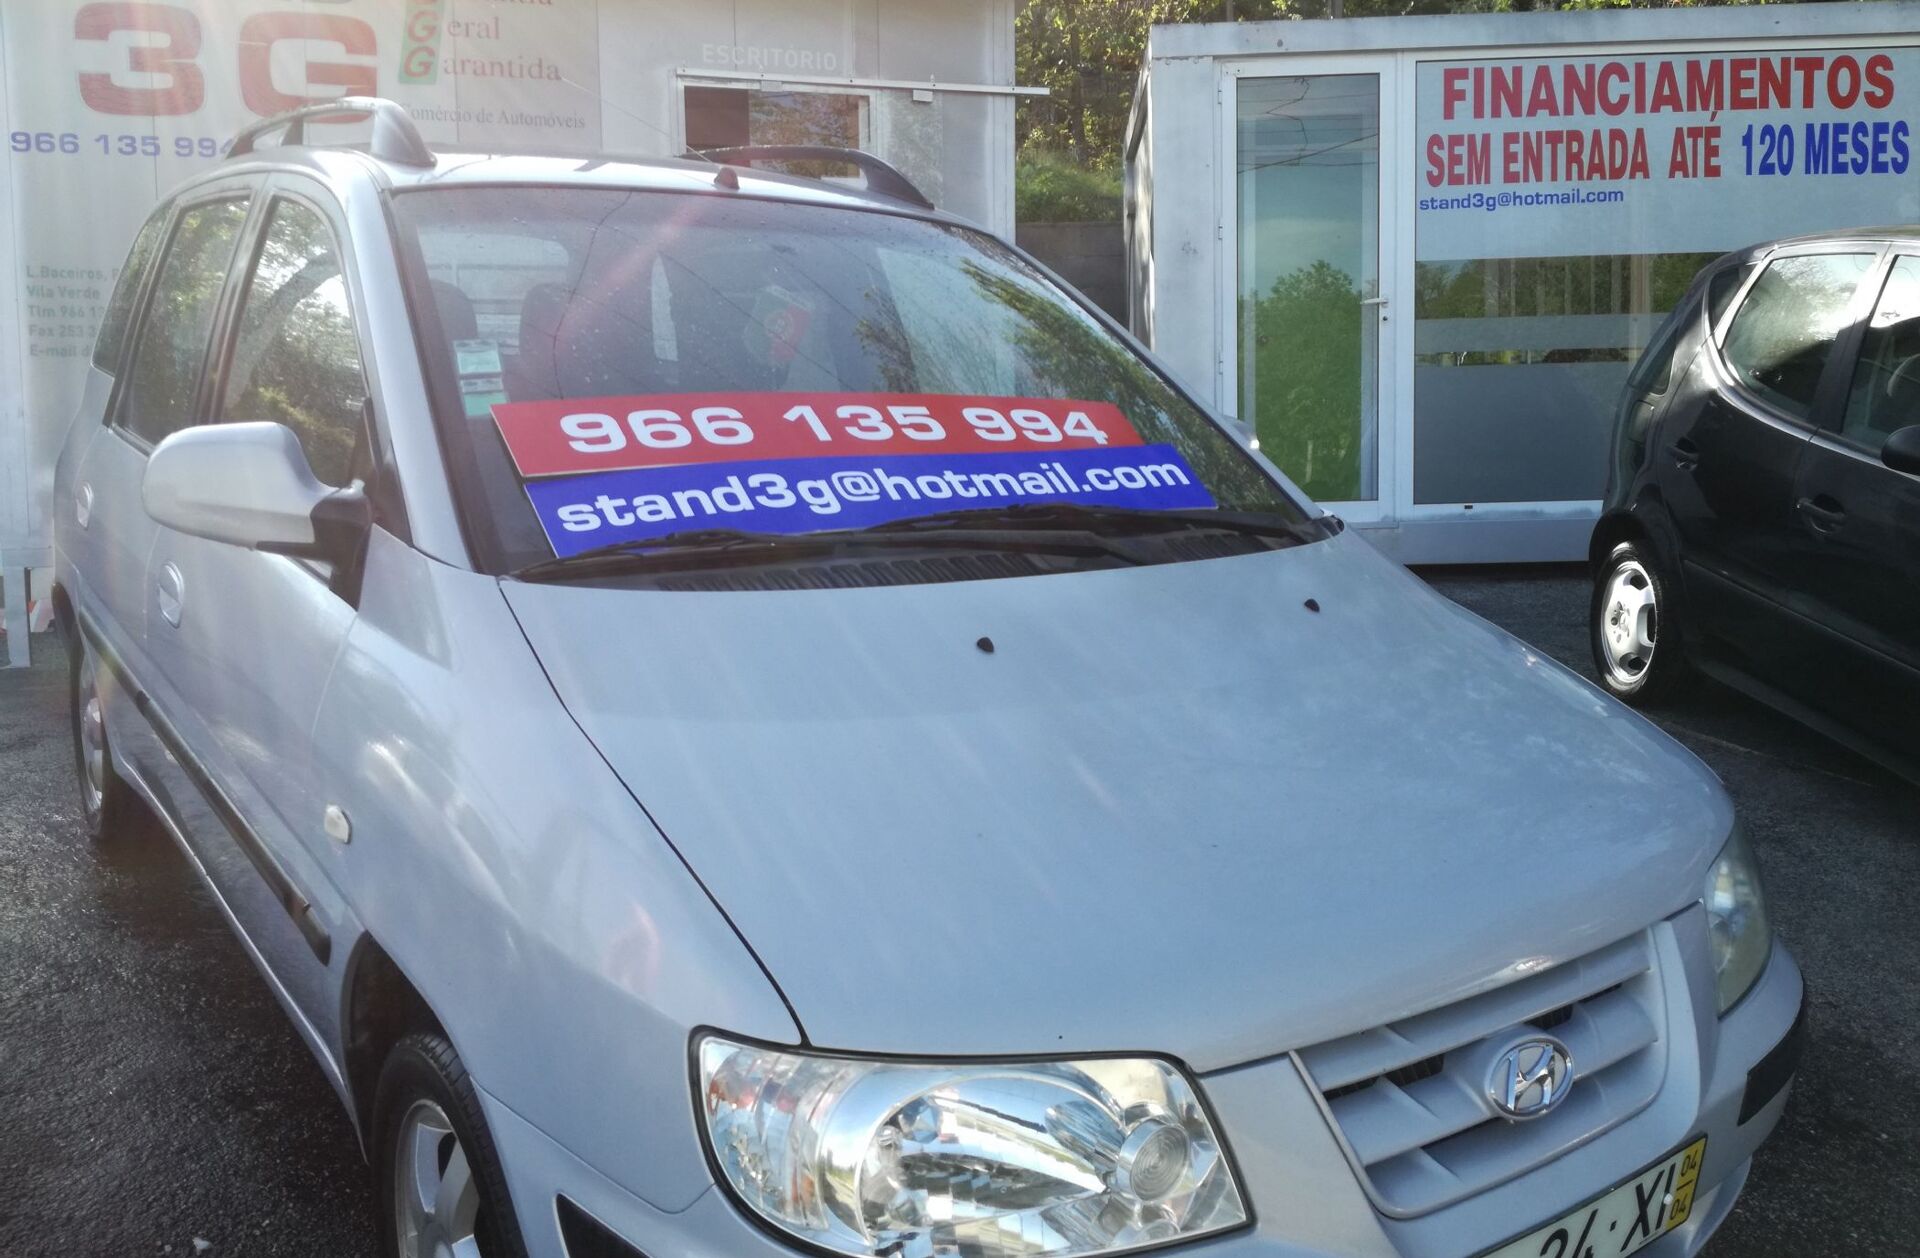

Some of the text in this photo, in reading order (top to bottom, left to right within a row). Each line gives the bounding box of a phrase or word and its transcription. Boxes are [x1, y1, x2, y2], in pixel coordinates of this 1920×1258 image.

[1443, 54, 1895, 121] FINANCIAMENTOS
[475, 106, 494, 124] de
[499, 108, 586, 129] Automóveis
[10, 131, 80, 154] 966
[94, 134, 161, 157] 135
[1426, 110, 1910, 188] SEM ENTRADA ATÉ 120 MESES
[1419, 188, 1625, 212] stand3g@hotmail.com
[560, 404, 1109, 453] 966 135 994
[556, 462, 1191, 532] stand3g@hotmail.com
[1679, 1149, 1698, 1178] 04
[1669, 1198, 1687, 1221] 04
